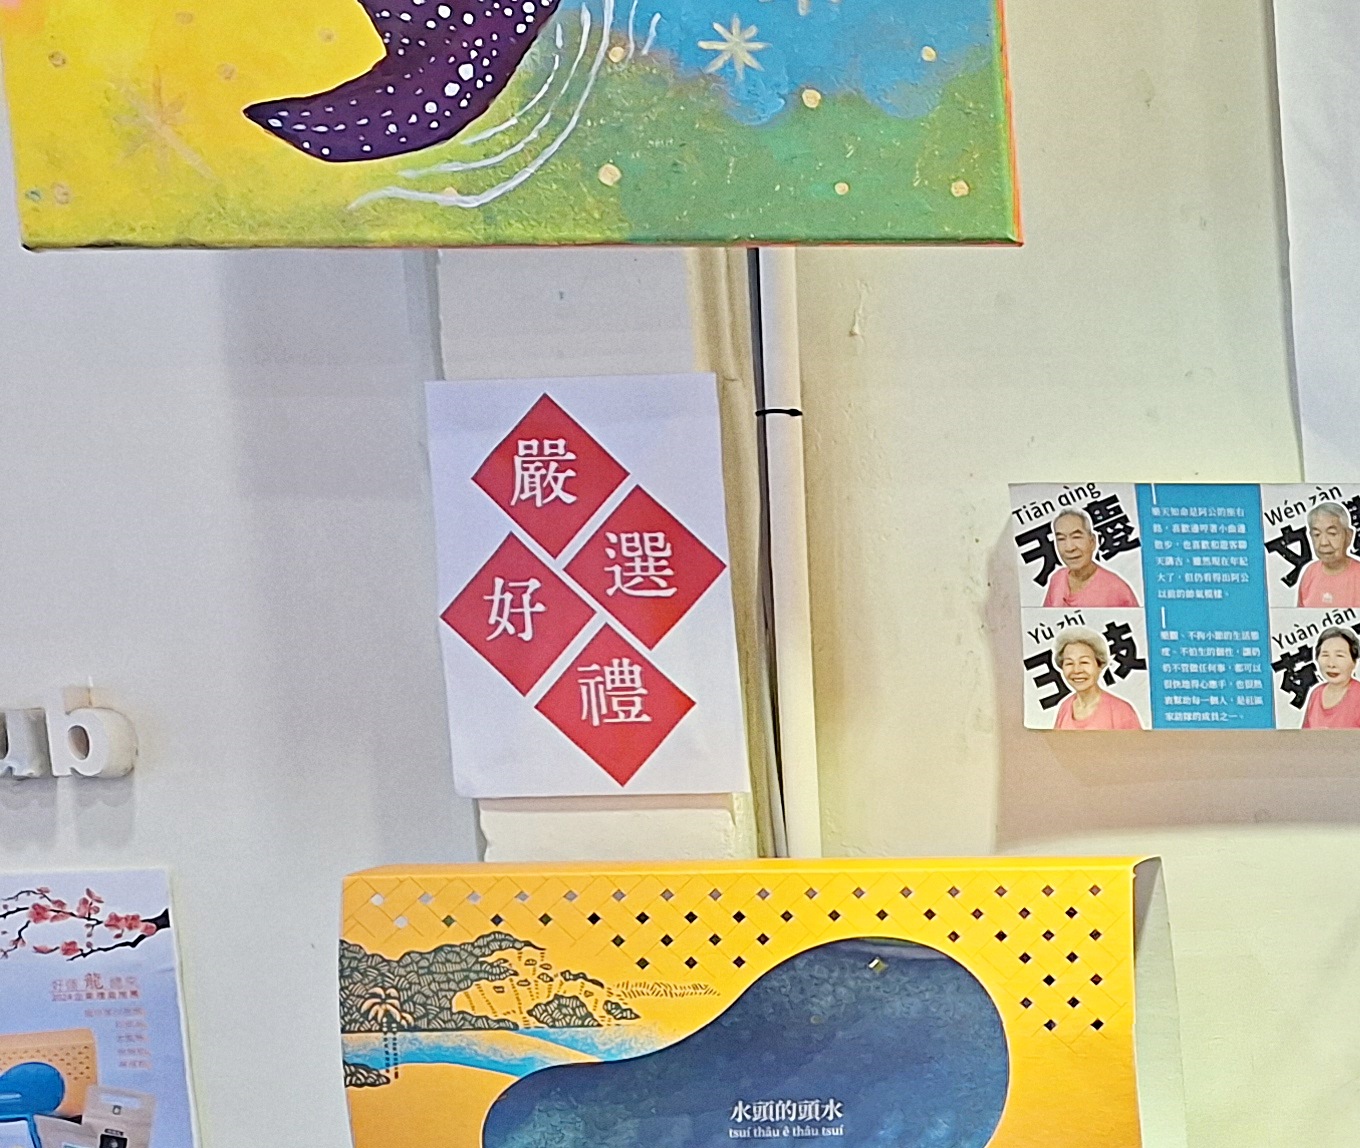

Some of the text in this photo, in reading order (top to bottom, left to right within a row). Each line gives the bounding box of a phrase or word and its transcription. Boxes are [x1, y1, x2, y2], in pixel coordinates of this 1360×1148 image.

[1263, 499, 1307, 527] Wén
[1027, 622, 1055, 645] Yù
[1271, 622, 1320, 650] Yuàn
[729, 1099, 844, 1123] 水頭的頭水
